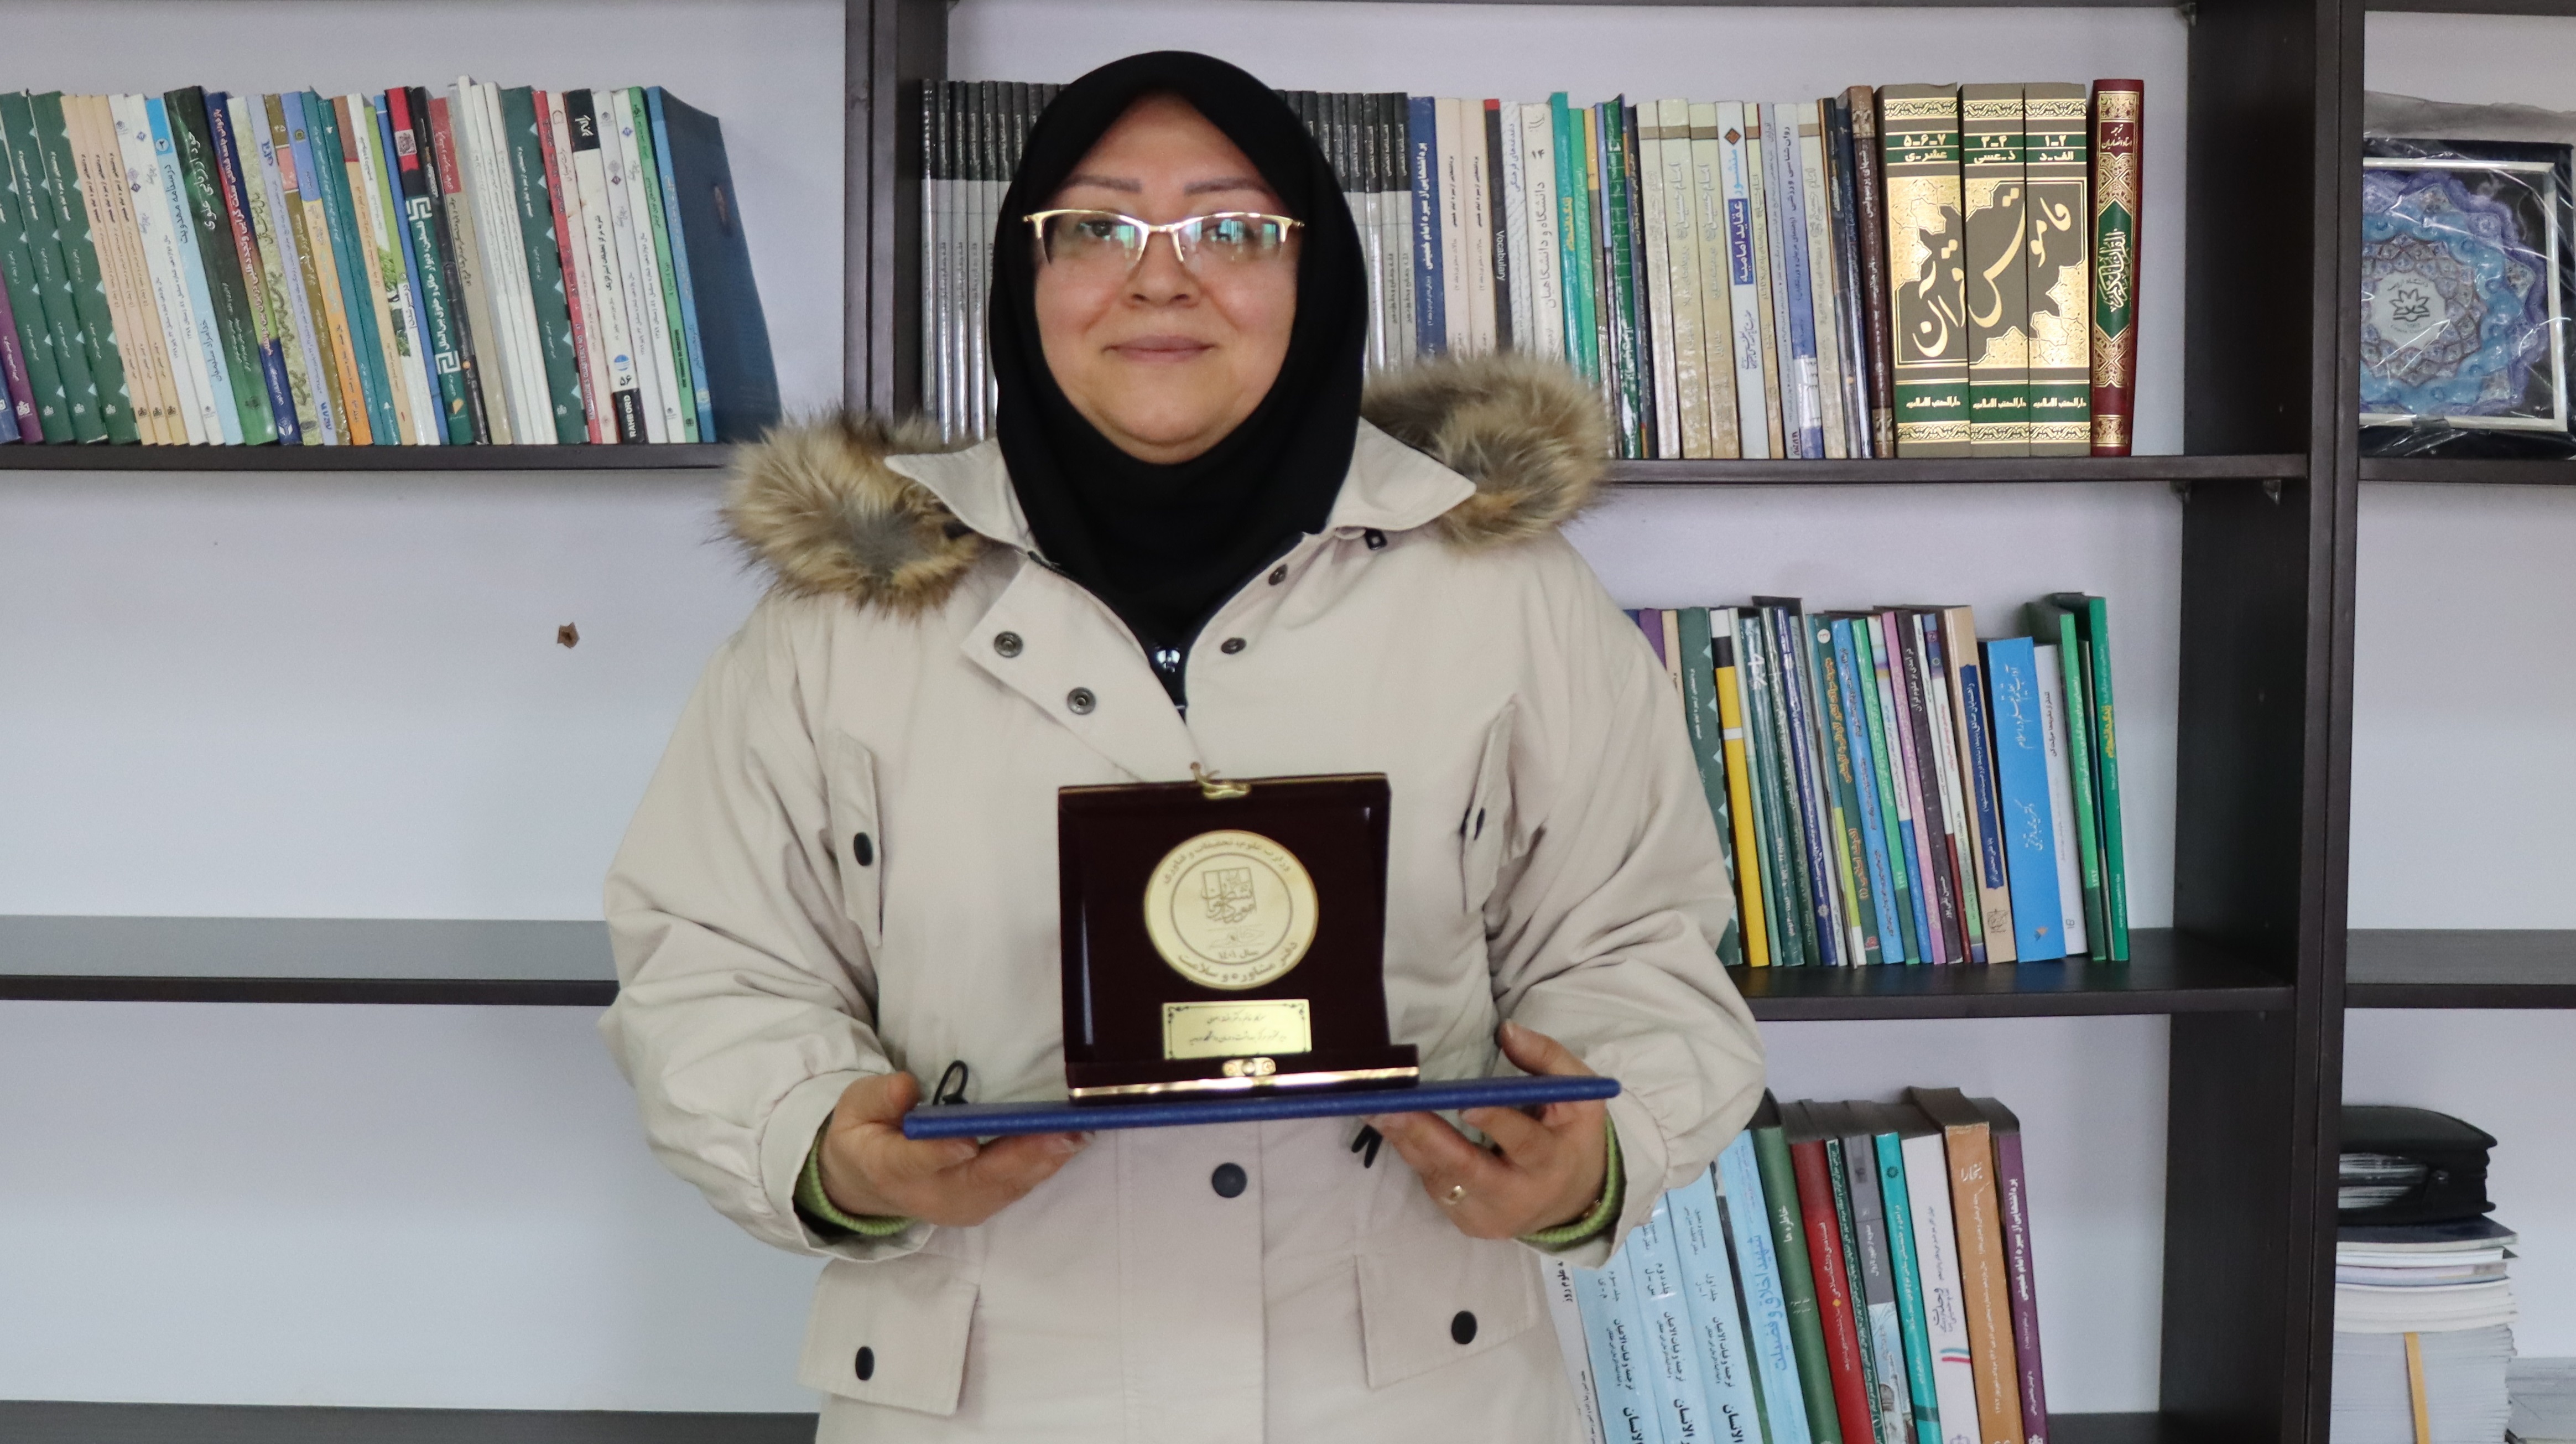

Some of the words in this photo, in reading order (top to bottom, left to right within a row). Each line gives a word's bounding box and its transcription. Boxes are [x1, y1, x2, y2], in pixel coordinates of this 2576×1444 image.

[212, 107, 226, 138] بازخوانی
[574, 113, 594, 138] راهبرد
[186, 129, 201, 154] خود
[218, 137, 230, 157] جامعه
[189, 155, 213, 198] ارزیابی
[222, 155, 236, 184] شناختی
[1416, 142, 1430, 190] برداشتهایی
[1508, 163, 1520, 192] فرهنگی
[1668, 161, 1686, 190] امام
[1697, 163, 1714, 191] امام
[1727, 148, 1743, 196] منشور
[162, 163, 180, 204] درسنامه
[173, 204, 190, 245] مهدویت
[228, 184, 240, 208] سنت
[1418, 190, 1430, 199] از
[1534, 181, 1547, 228] دانشگاه
[199, 199, 218, 231] علوی
[232, 207, 248, 235] گرایی
[1418, 199, 1432, 221] سیره
[1671, 190, 1689, 229] حسین
[1700, 191, 1718, 230] حسین
[1731, 200, 1748, 239] عقاید
[1785, 180, 1796, 211] ورزشی
[1791, 243, 1799, 263] مربیان
[415, 219, 431, 252] فلسطین،
[1420, 222, 1433, 240] امام
[423, 251, 435, 272] دیوار
[599, 243, 608, 264] تحقیقات
[1420, 241, 1434, 271] خمینی
[1493, 230, 1508, 281] Vocabulary
[1734, 240, 1750, 282] امامیه
[425, 272, 439, 292] حائل
[602, 264, 613, 291] استراتژیک
[1538, 240, 1555, 309] دانشگاهیان
[258, 311, 267, 325] بین
[431, 296, 445, 318] حقوق
[199, 318, 214, 349] خدامراد
[206, 349, 222, 383] سلیمیان
[623, 393, 637, 438] RAHBORD
[1849, 827, 1862, 856] اندیشه
[1852, 855, 1868, 887] اسلامی
[1178, 954, 1218, 977] سلامت
[1279, 941, 1298, 967] دفتر
[1231, 964, 1276, 983] مشاوره
[1959, 1161, 1985, 1183] بخارا
[2006, 1178, 2022, 1224] برداشتهایی
[1777, 1203, 1794, 1232] خاطره
[2011, 1223, 2023, 1233] از
[1746, 1233, 1771, 1271] شهید
[1781, 1233, 1793, 1243] ها
[2012, 1233, 2026, 1255] سیره
[2015, 1255, 2028, 1273] امام
[1755, 1270, 1781, 1311] اخلاق
[2017, 1272, 2032, 1301] خمینی
[1767, 1310, 1783, 1320] و
[1929, 1286, 1948, 1326] وحدت
[1767, 1320, 1791, 1371] فضیلت
[1673, 1396, 1694, 1439] الانسان
